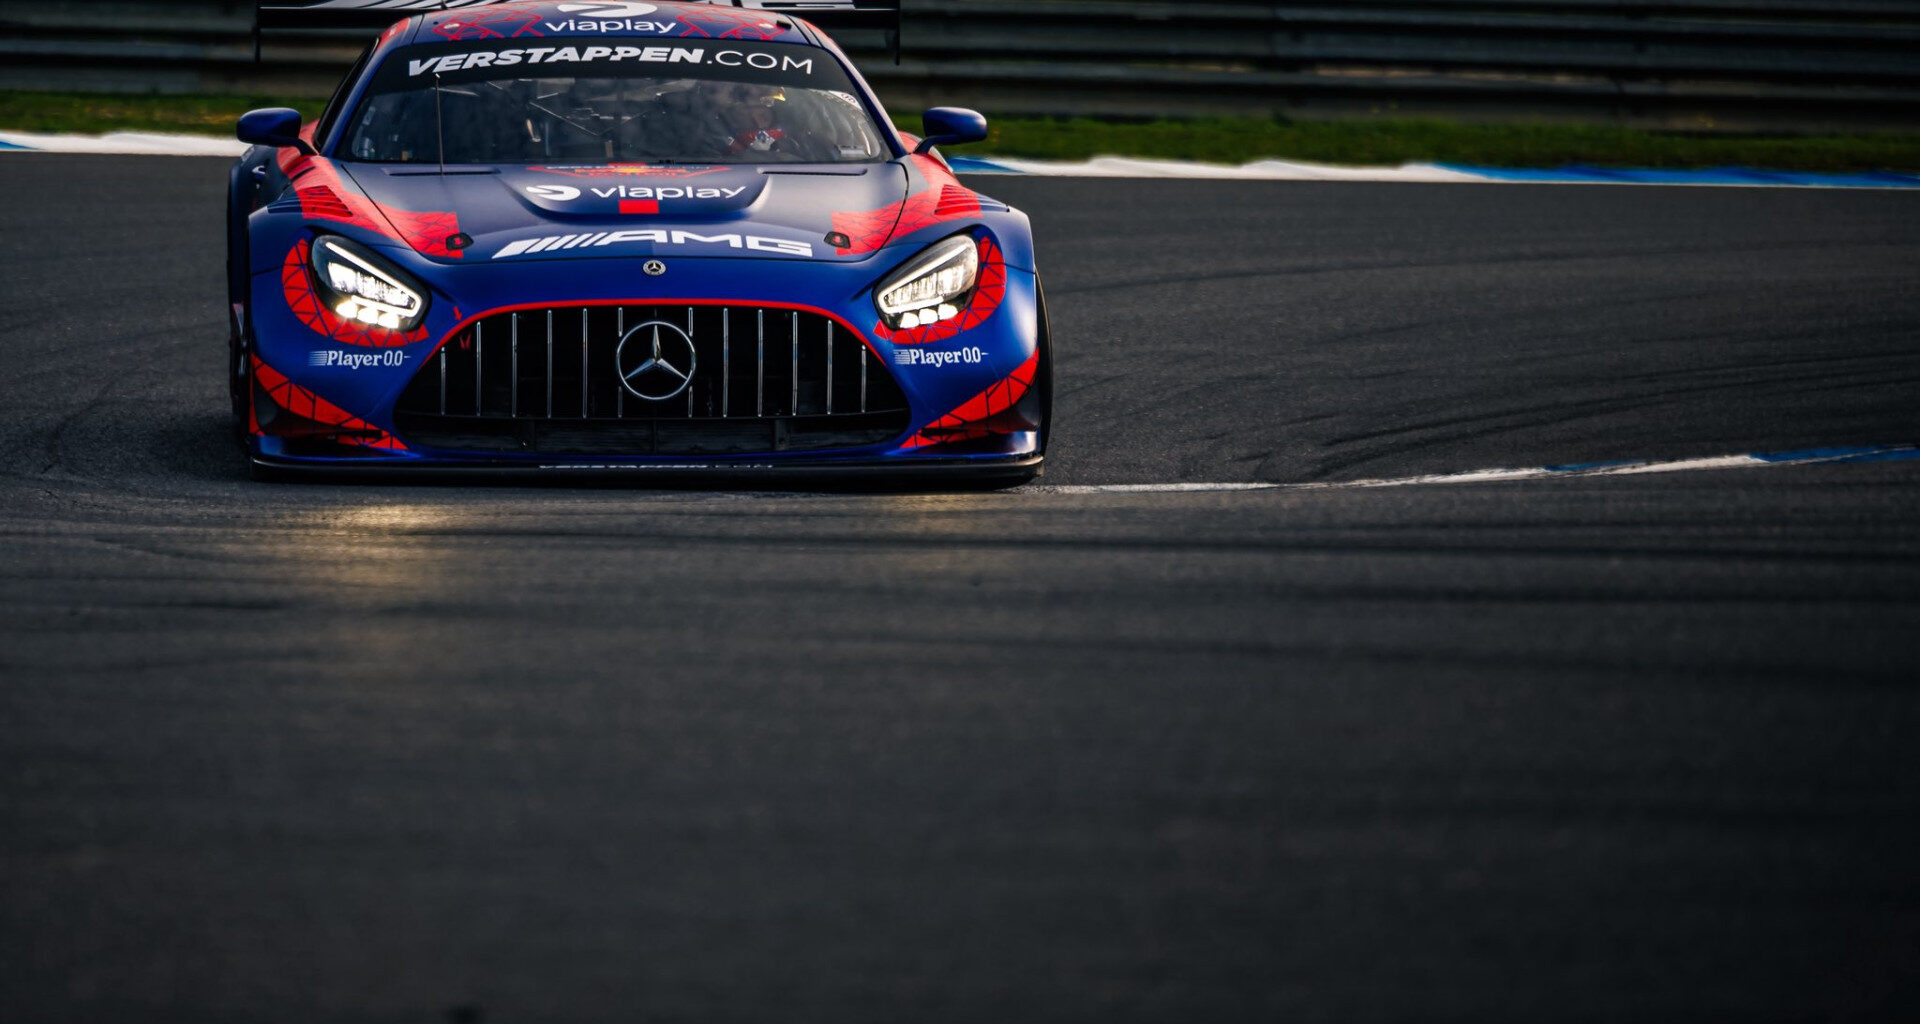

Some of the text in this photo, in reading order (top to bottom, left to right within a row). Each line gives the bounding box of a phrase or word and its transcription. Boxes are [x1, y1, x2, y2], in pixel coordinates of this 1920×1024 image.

[545, 19, 677, 34] viaplay
[408, 46, 813, 77] VERSTAPPEN.COM
[590, 185, 747, 200] viaplay
[594, 230, 813, 257] AMG
[327, 350, 383, 369] Player
[909, 349, 962, 367] Player
